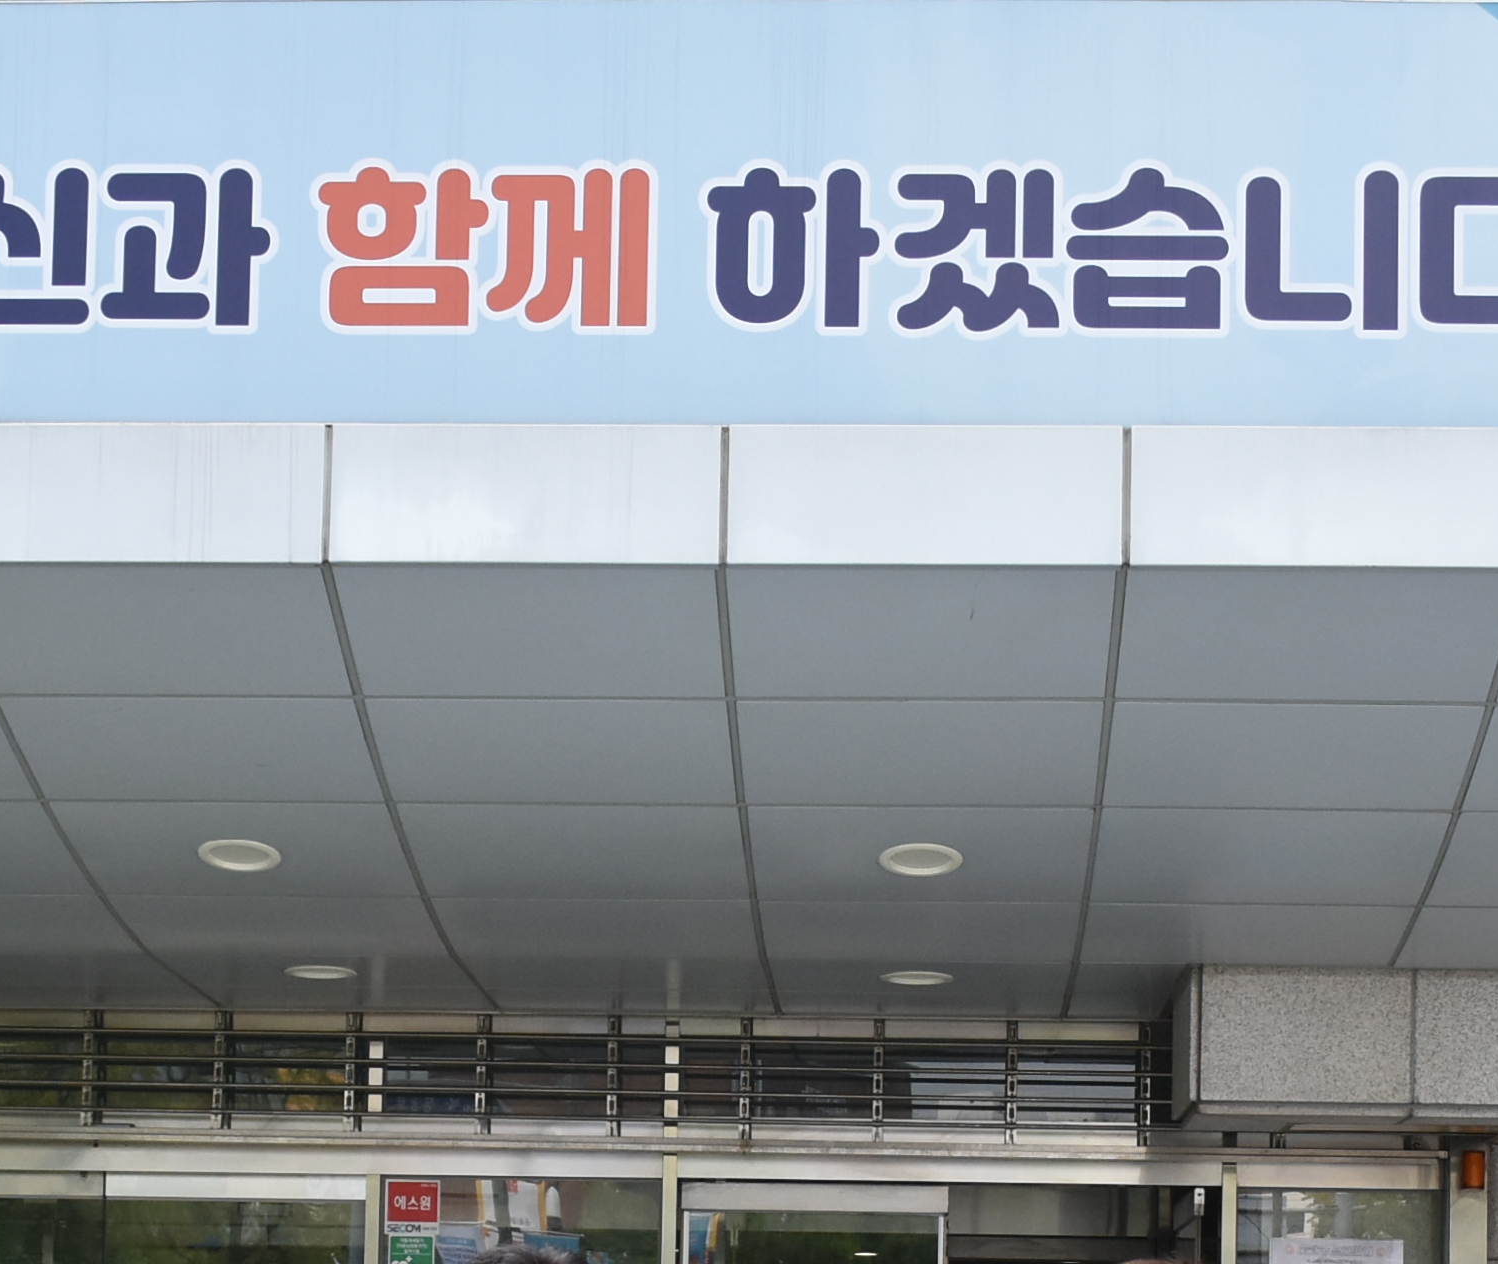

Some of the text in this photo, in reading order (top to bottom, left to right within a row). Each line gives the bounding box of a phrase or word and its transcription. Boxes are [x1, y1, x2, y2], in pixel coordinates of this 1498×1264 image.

[316, 165, 651, 328] 함께
[393, 1195, 432, 1211] 에스원
[387, 1223, 421, 1233] SECOM
